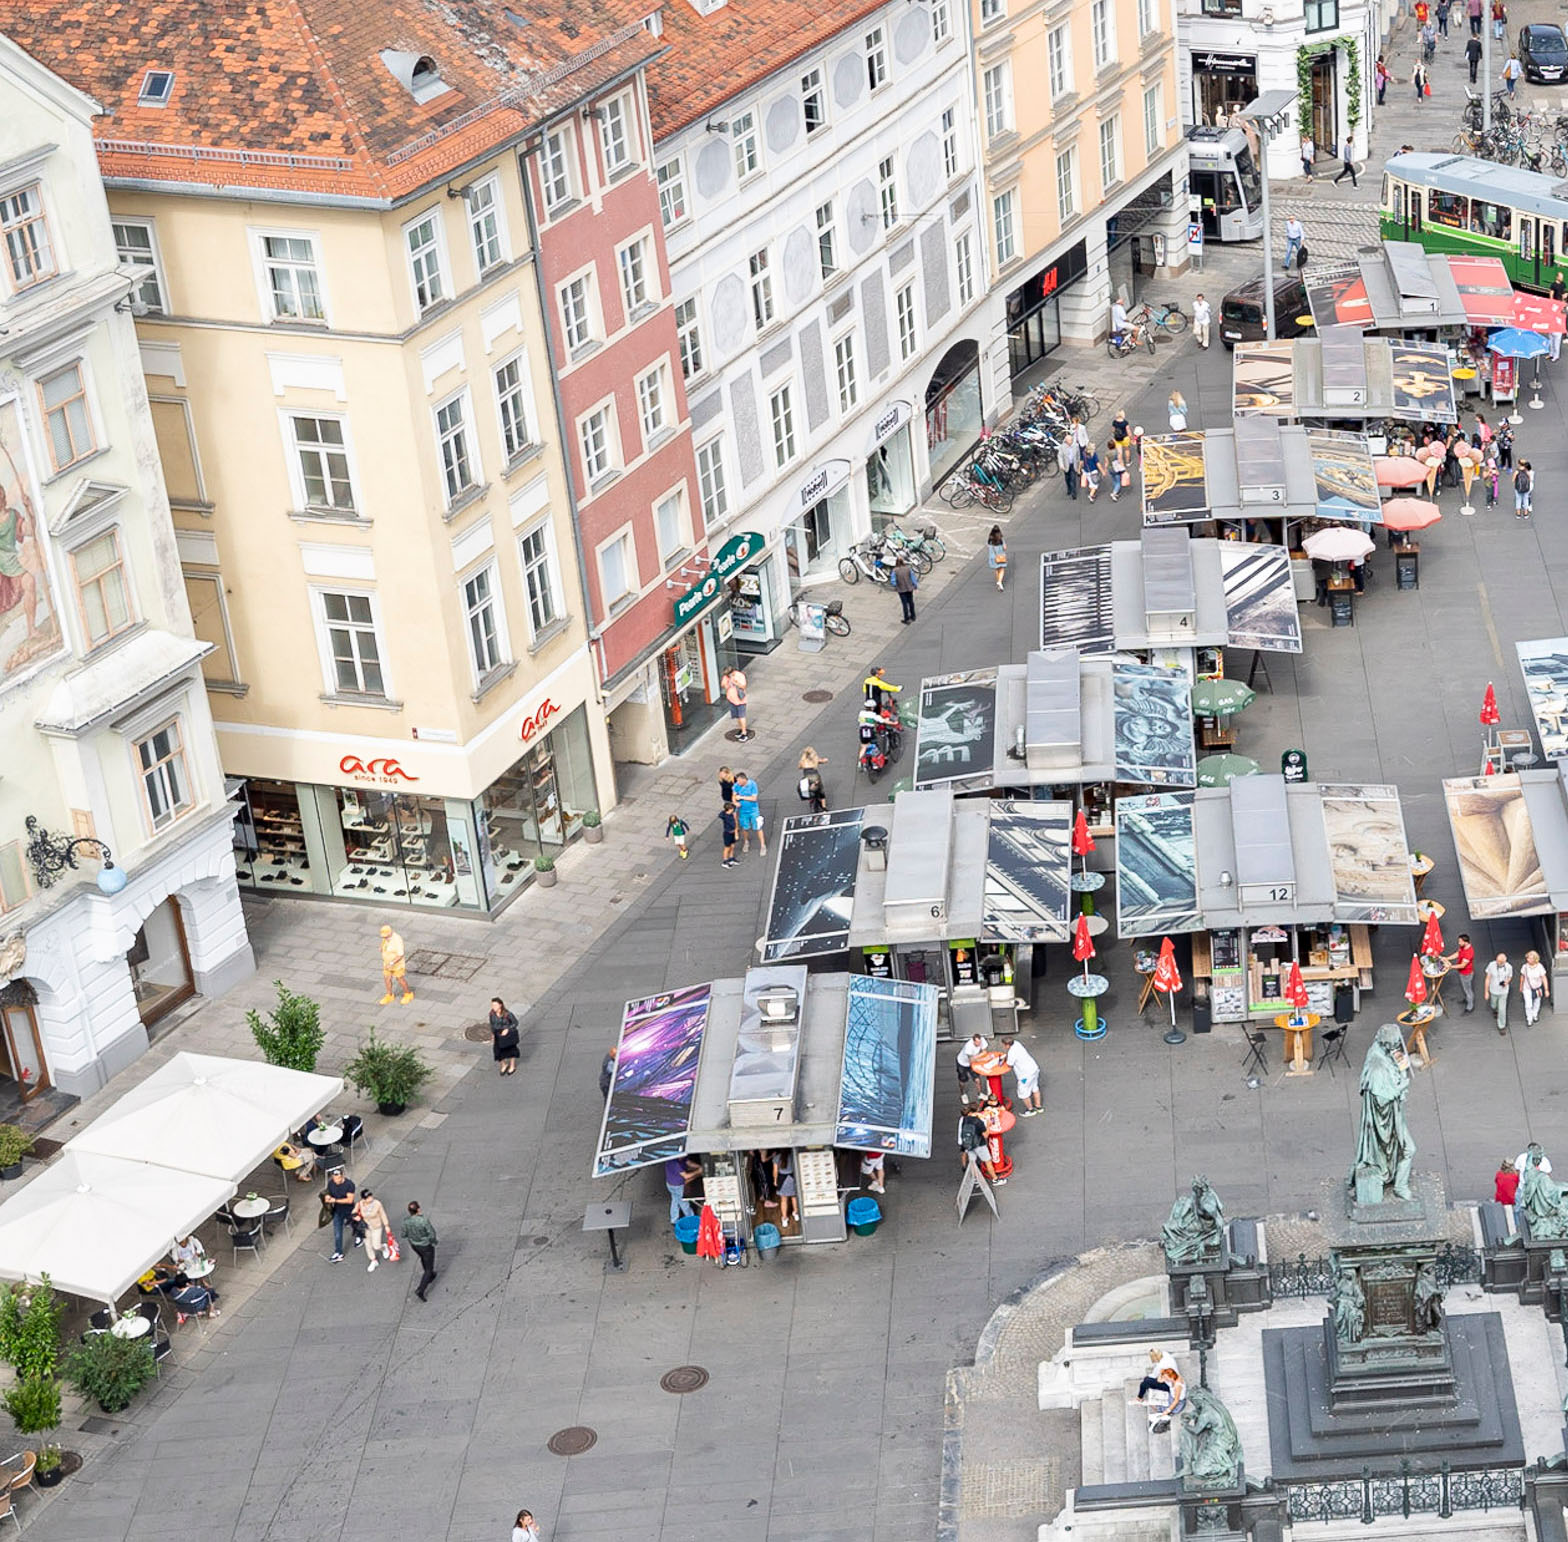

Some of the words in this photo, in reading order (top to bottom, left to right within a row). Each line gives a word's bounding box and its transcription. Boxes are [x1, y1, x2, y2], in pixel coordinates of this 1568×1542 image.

[1430, 303, 1436, 312] 1
[1353, 391, 1361, 401] 2
[1272, 490, 1280, 500] 3
[679, 588, 703, 617] Pearle
[1179, 616, 1188, 627] 4
[521, 698, 561, 740] ara
[340, 755, 419, 781] ara
[1269, 888, 1288, 901] 12
[930, 905, 940, 918] 6
[773, 1108, 784, 1121] 7
